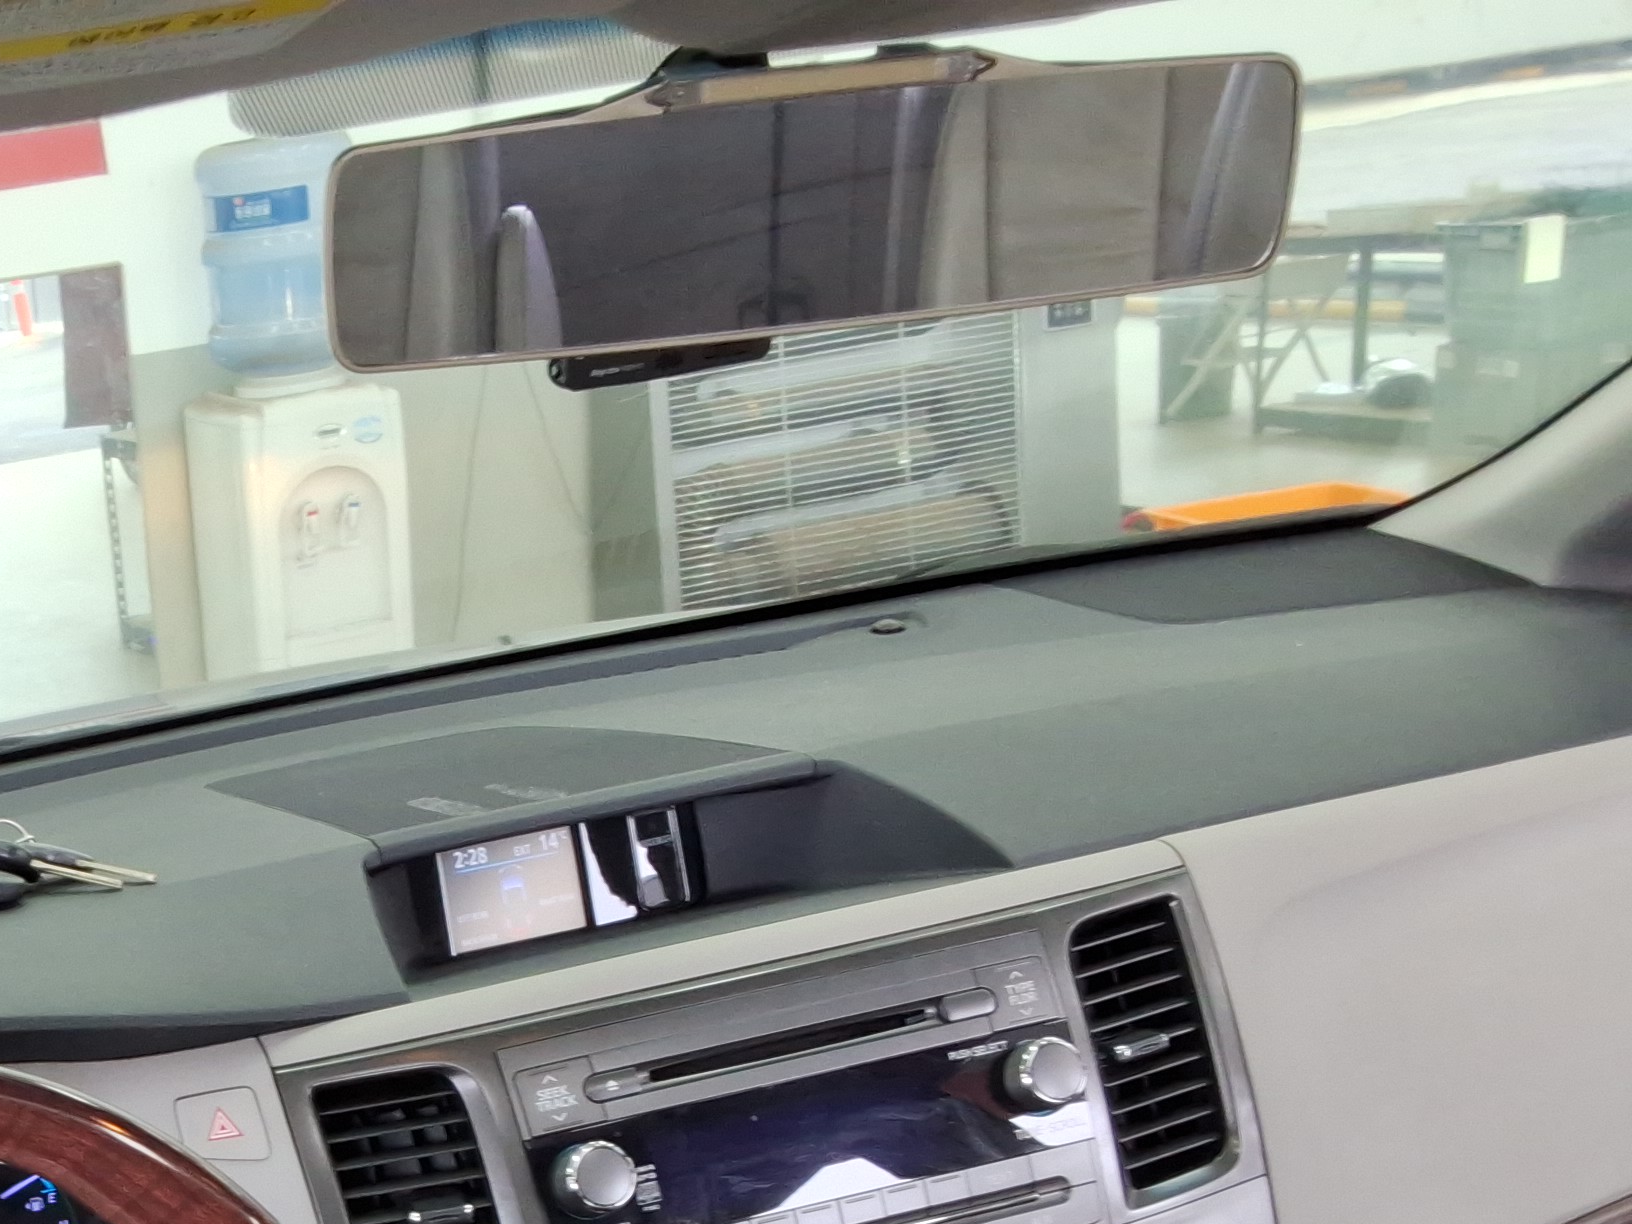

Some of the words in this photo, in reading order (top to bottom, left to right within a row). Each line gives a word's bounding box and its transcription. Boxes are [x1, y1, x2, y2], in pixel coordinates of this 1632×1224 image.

[452, 847, 489, 869] 2:28
[536, 1085, 570, 1098] SEEK
[534, 1095, 579, 1112] TRACK
[47, 1192, 57, 1204] E
